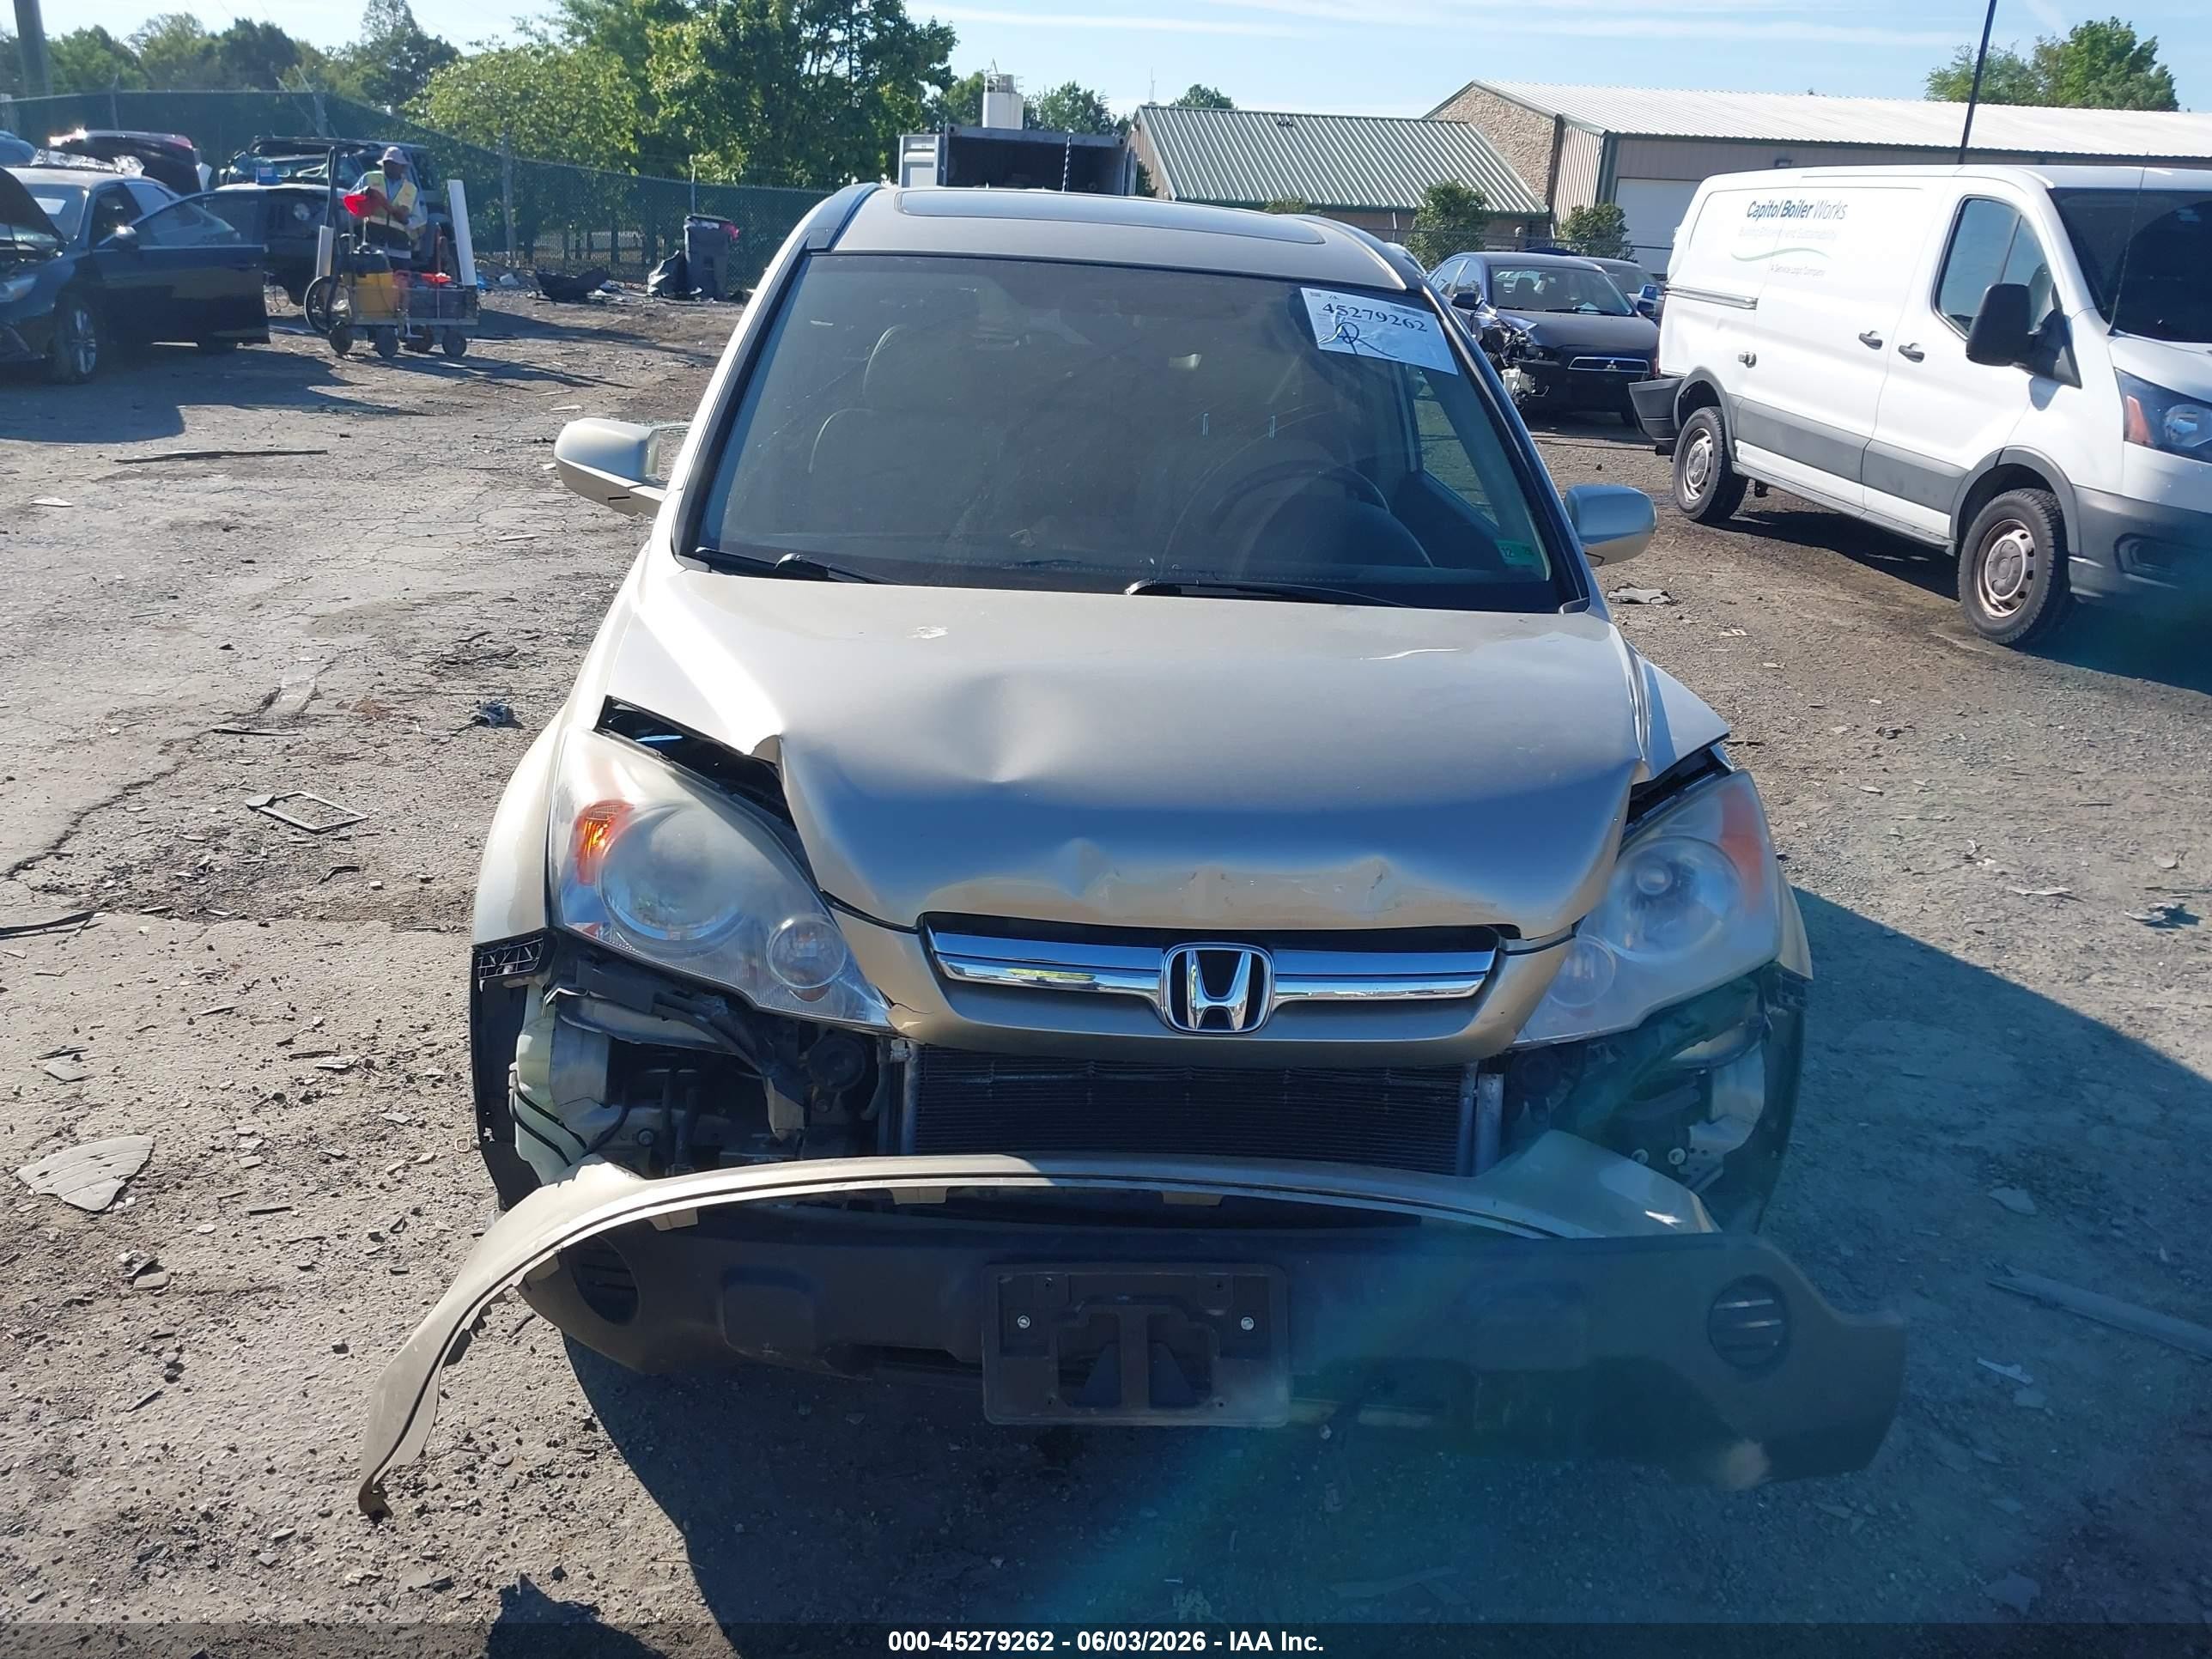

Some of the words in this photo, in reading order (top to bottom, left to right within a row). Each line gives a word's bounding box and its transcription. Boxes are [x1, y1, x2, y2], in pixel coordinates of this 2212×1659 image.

[1747, 199, 1784, 222] Capitol
[1780, 199, 1814, 219] Boiler
[1814, 199, 1849, 220] Works
[1322, 302, 1428, 332] 45279262
